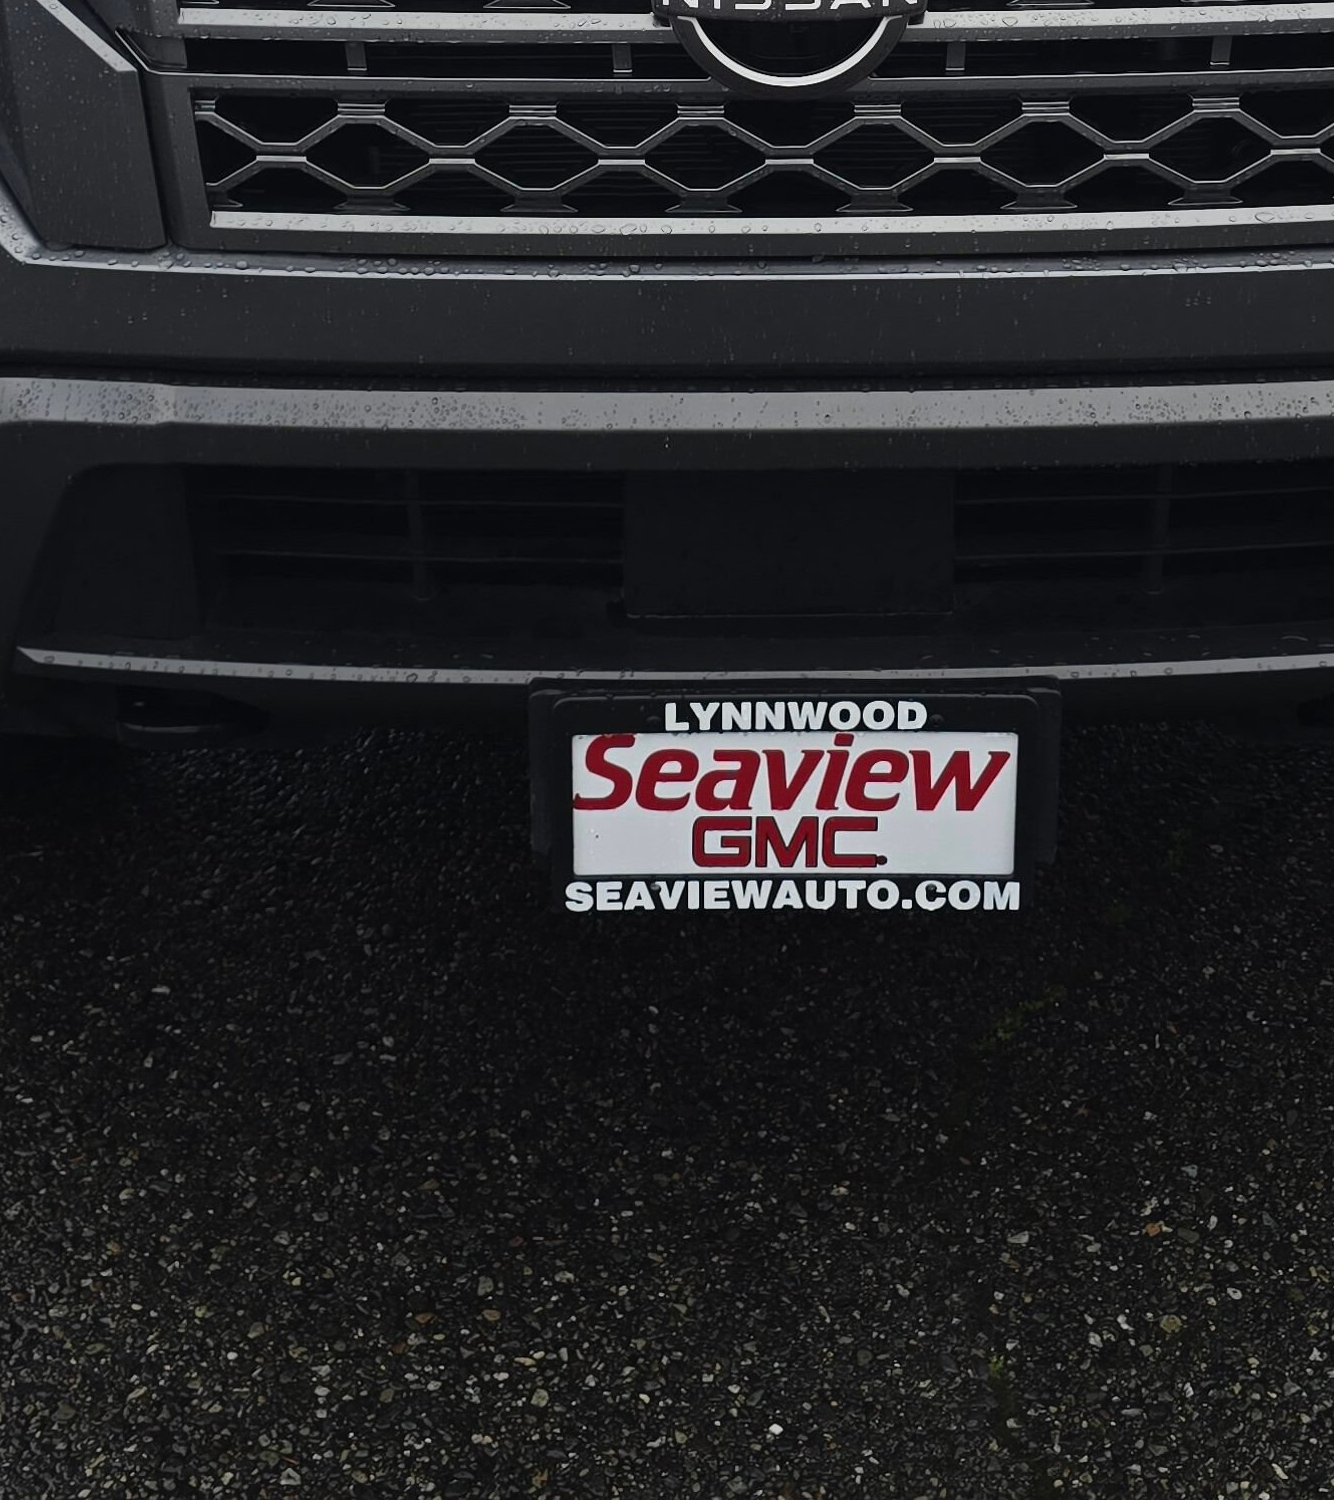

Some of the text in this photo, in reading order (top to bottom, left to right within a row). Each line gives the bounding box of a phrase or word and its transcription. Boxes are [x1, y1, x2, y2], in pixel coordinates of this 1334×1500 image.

[665, 700, 928, 732] LYNNWOOD
[572, 733, 1011, 812] Seaview
[692, 816, 879, 868] GMC
[565, 879, 1021, 912] SEAVIEWAUTO.COM
